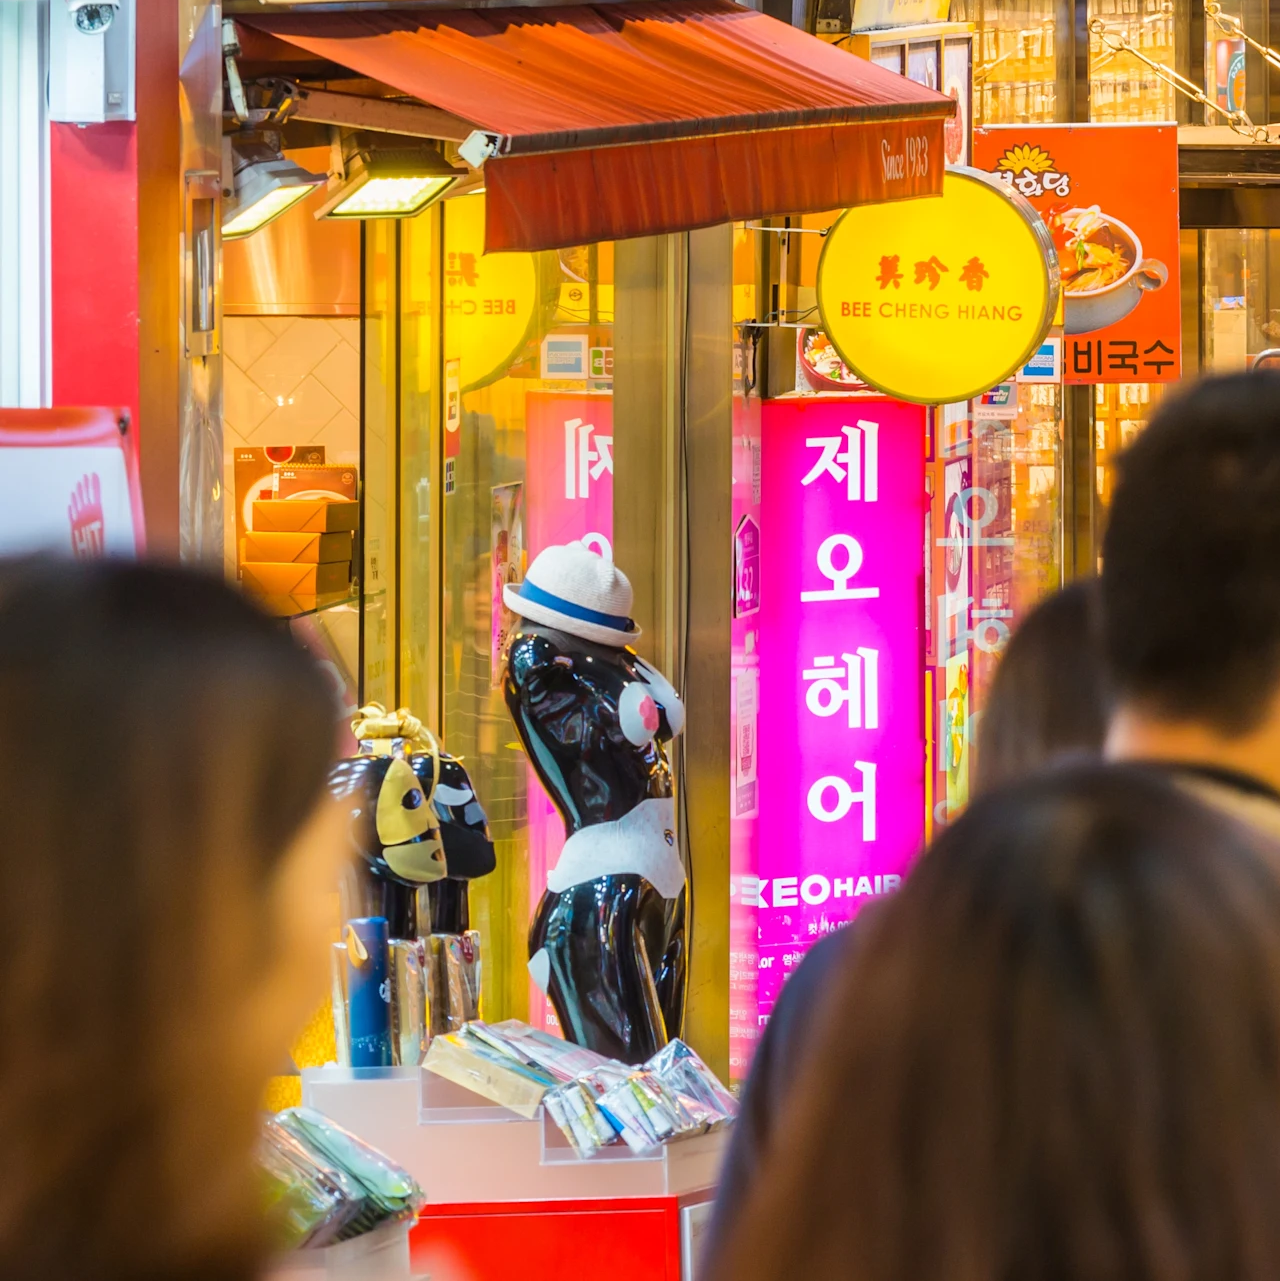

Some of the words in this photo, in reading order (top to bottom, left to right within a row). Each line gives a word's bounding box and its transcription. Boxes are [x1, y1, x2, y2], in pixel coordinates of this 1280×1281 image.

[880, 138, 904, 185] Since
[905, 135, 929, 179] 1933
[875, 253, 990, 293] 美珍香
[841, 301, 872, 318] BEE
[877, 302, 950, 320] CHENG
[956, 304, 1023, 322] HIANG
[1061, 338, 1175, 378] 비국수
[799, 417, 881, 843] 제오헤어
